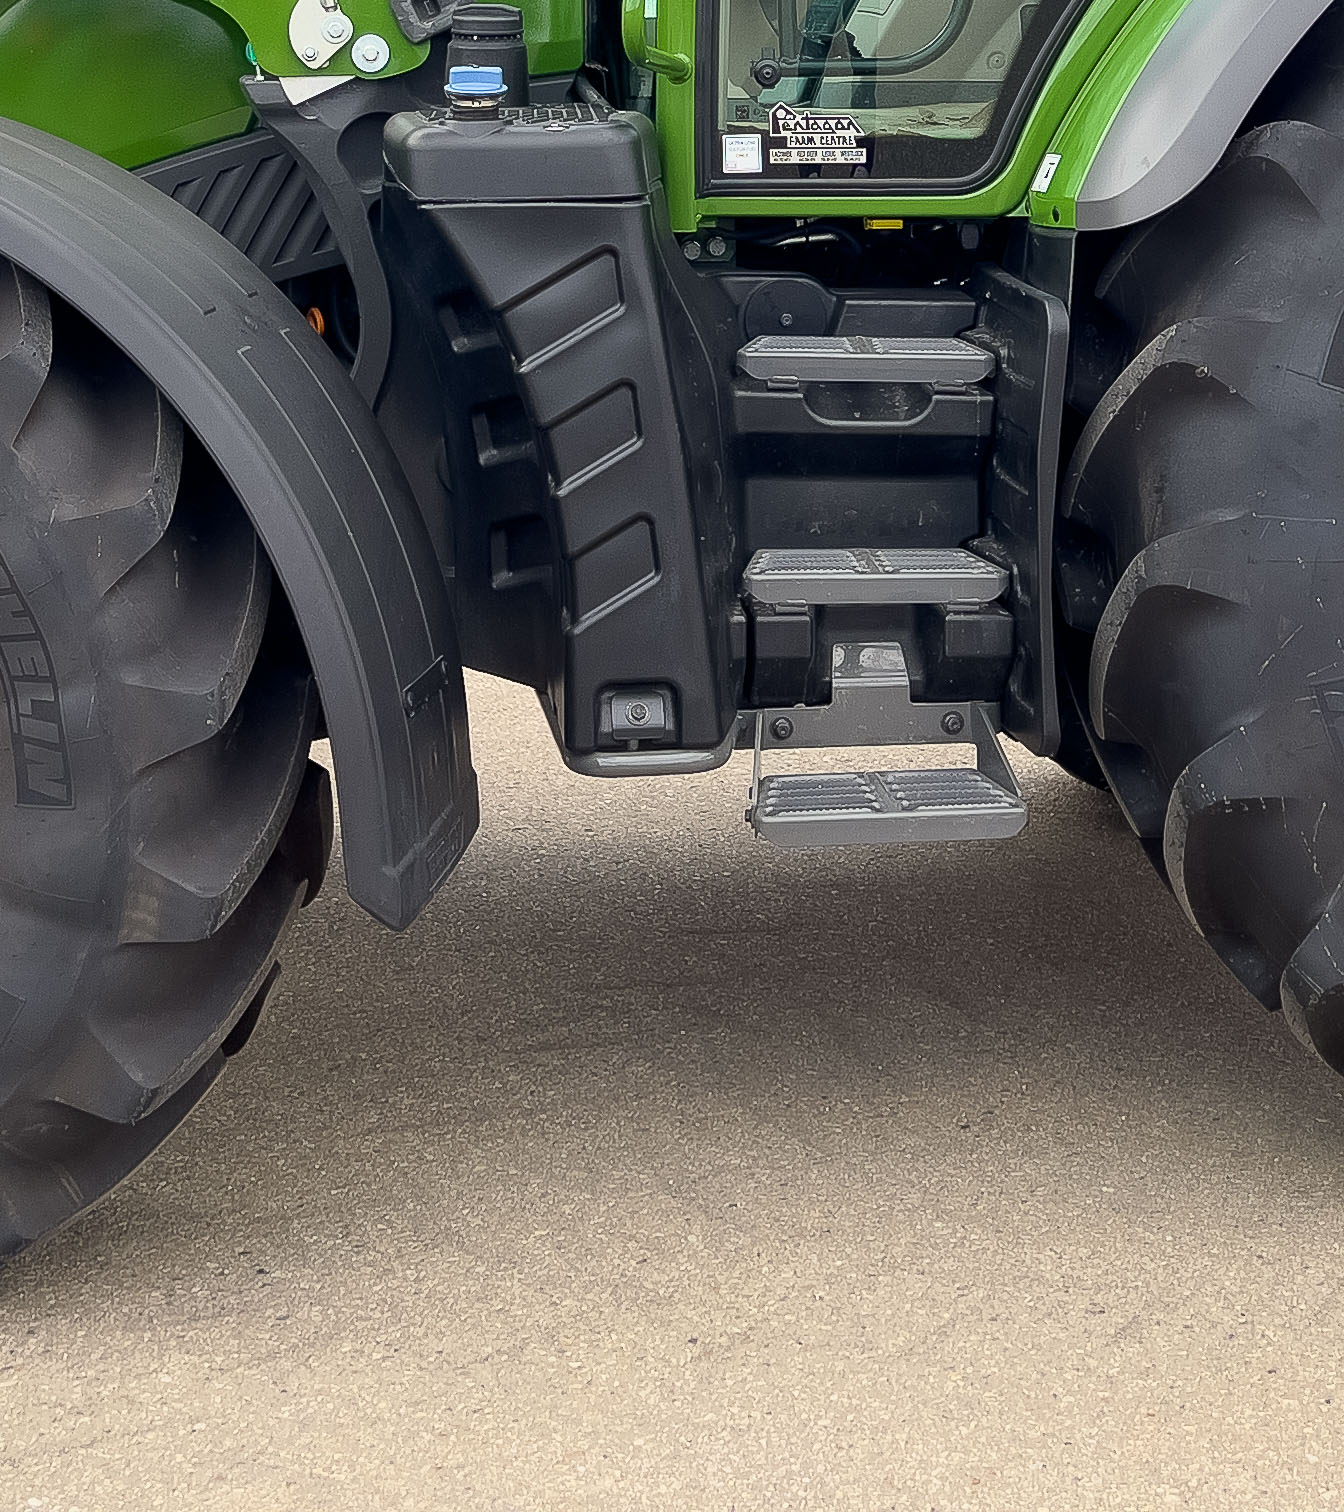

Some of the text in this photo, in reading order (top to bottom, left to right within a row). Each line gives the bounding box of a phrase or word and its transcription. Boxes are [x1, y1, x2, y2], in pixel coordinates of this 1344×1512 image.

[771, 103, 862, 135] Pentagon
[789, 136, 856, 146] FARM CENTRE
